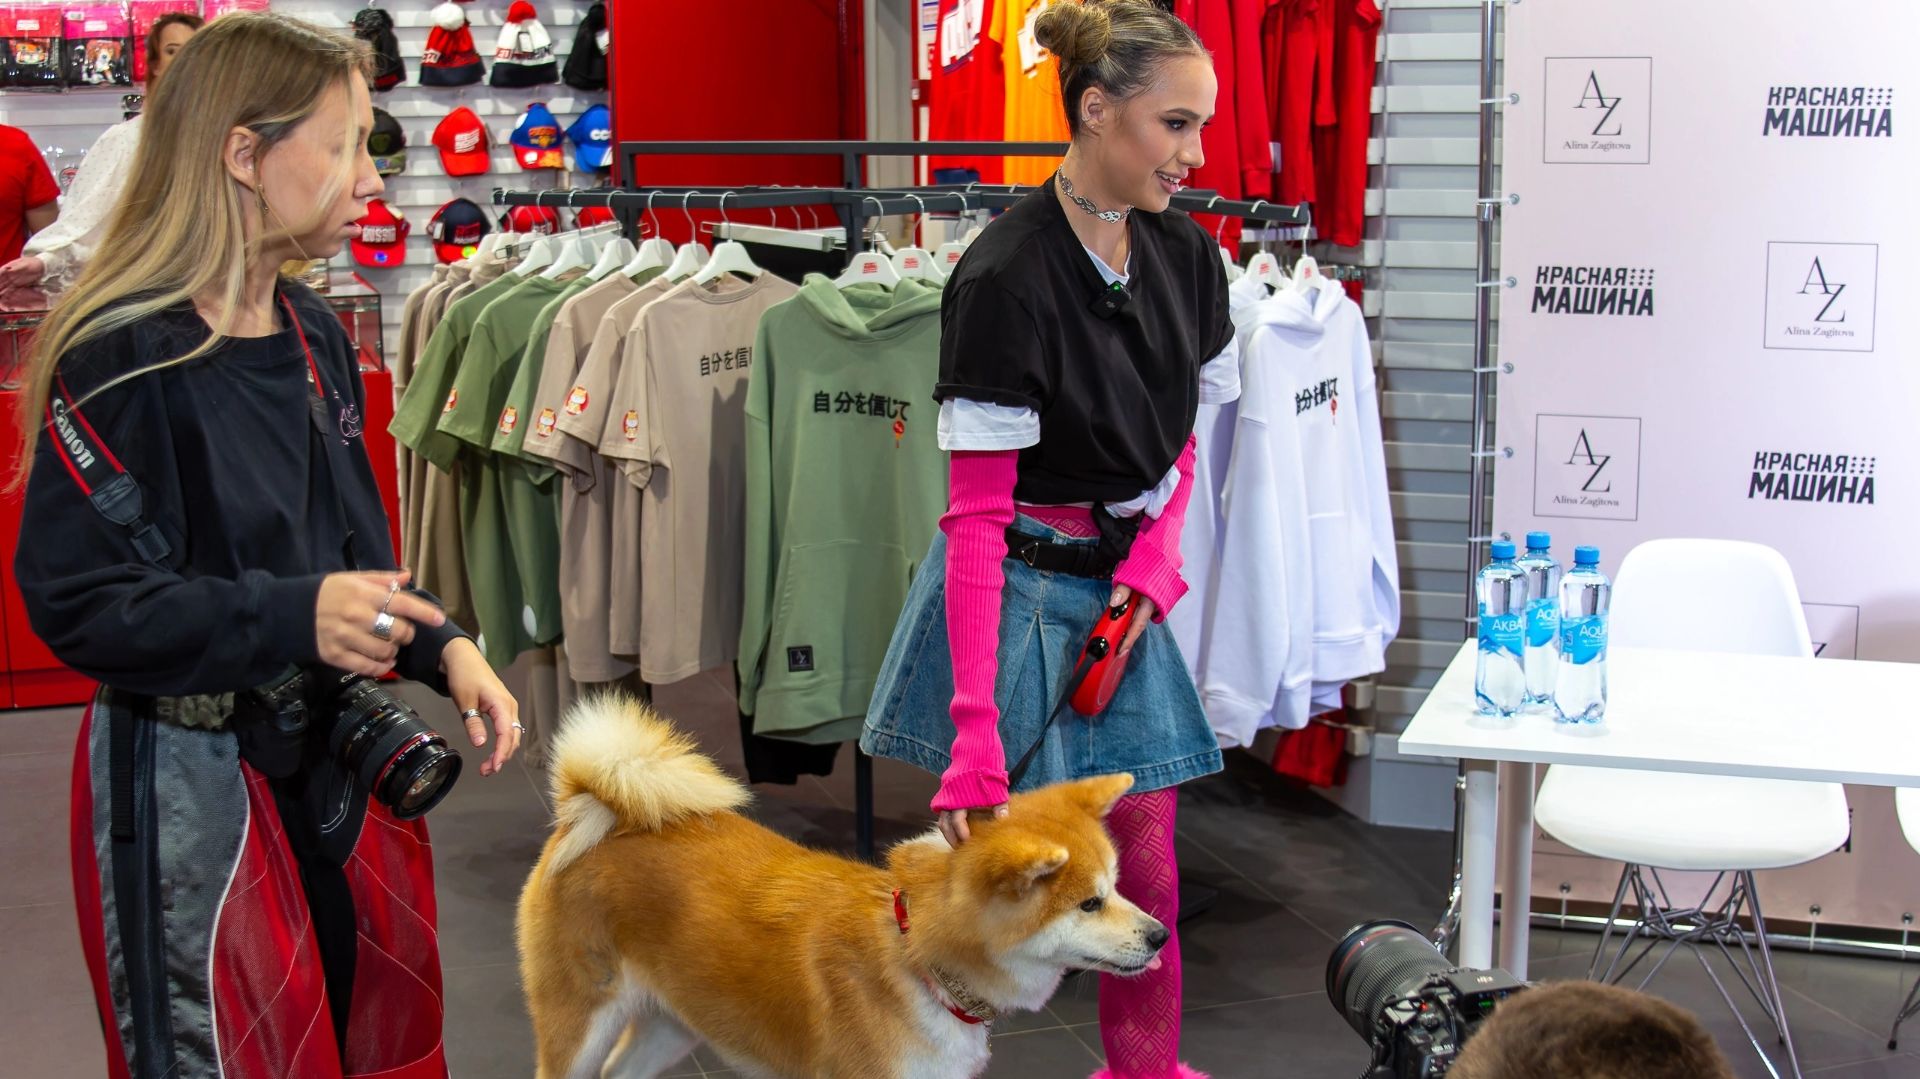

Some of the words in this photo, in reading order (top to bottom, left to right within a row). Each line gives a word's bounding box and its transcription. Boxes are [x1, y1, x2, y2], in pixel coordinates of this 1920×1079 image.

[1767, 86, 1865, 106] КРАСНАЯ
[1762, 107, 1893, 138] МАШИНА
[1563, 141, 1589, 151] Alina
[1591, 141, 1631, 152] Zagitova
[1535, 265, 1628, 286] КРАСНАЯ
[1531, 286, 1654, 316] МАШИНА
[1785, 326, 1811, 336] Alina
[1812, 327, 1855, 338] Zagitova
[700, 346, 753, 377] 自分を信
[813, 390, 911, 422] 自分を信じて
[52, 398, 96, 470] Canon
[1753, 451, 1849, 473] КРАСНАЯ
[1748, 472, 1875, 504] МАШИНА
[1553, 495, 1578, 505] Alina
[1579, 496, 1620, 508] Zagitova
